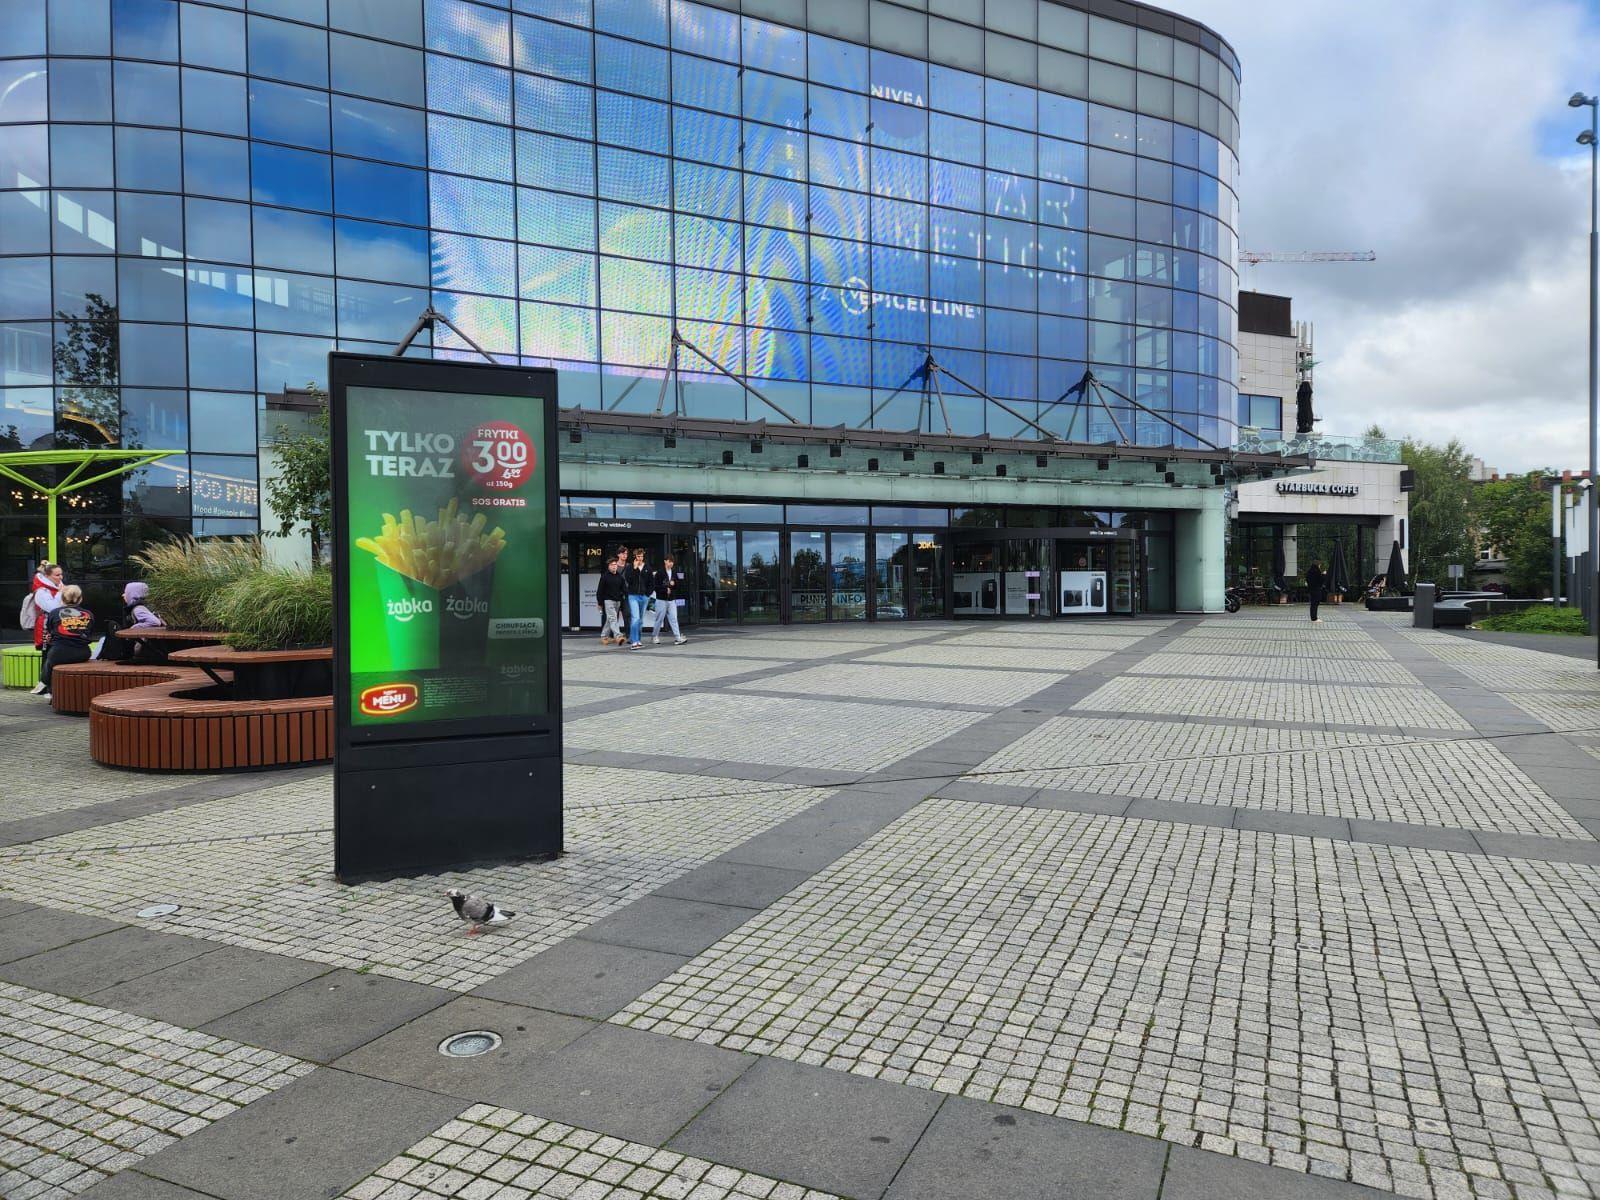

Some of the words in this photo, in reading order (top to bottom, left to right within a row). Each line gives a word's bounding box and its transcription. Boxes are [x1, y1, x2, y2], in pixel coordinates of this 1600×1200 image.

[870, 83, 924, 107] NIVEA
[477, 428, 519, 439] FRYTKI
[364, 429, 455, 453] TYLKO
[365, 454, 455, 478] TERAZ
[495, 480, 513, 488] 150g
[1278, 482, 1330, 493] STARBUCKS
[492, 499, 526, 507] GRATIS
[446, 595, 489, 613] żabka
[800, 594, 828, 605] PUNK
[836, 593, 862, 604] INFO
[386, 598, 433, 615] żabka
[373, 694, 406, 706] MENU
